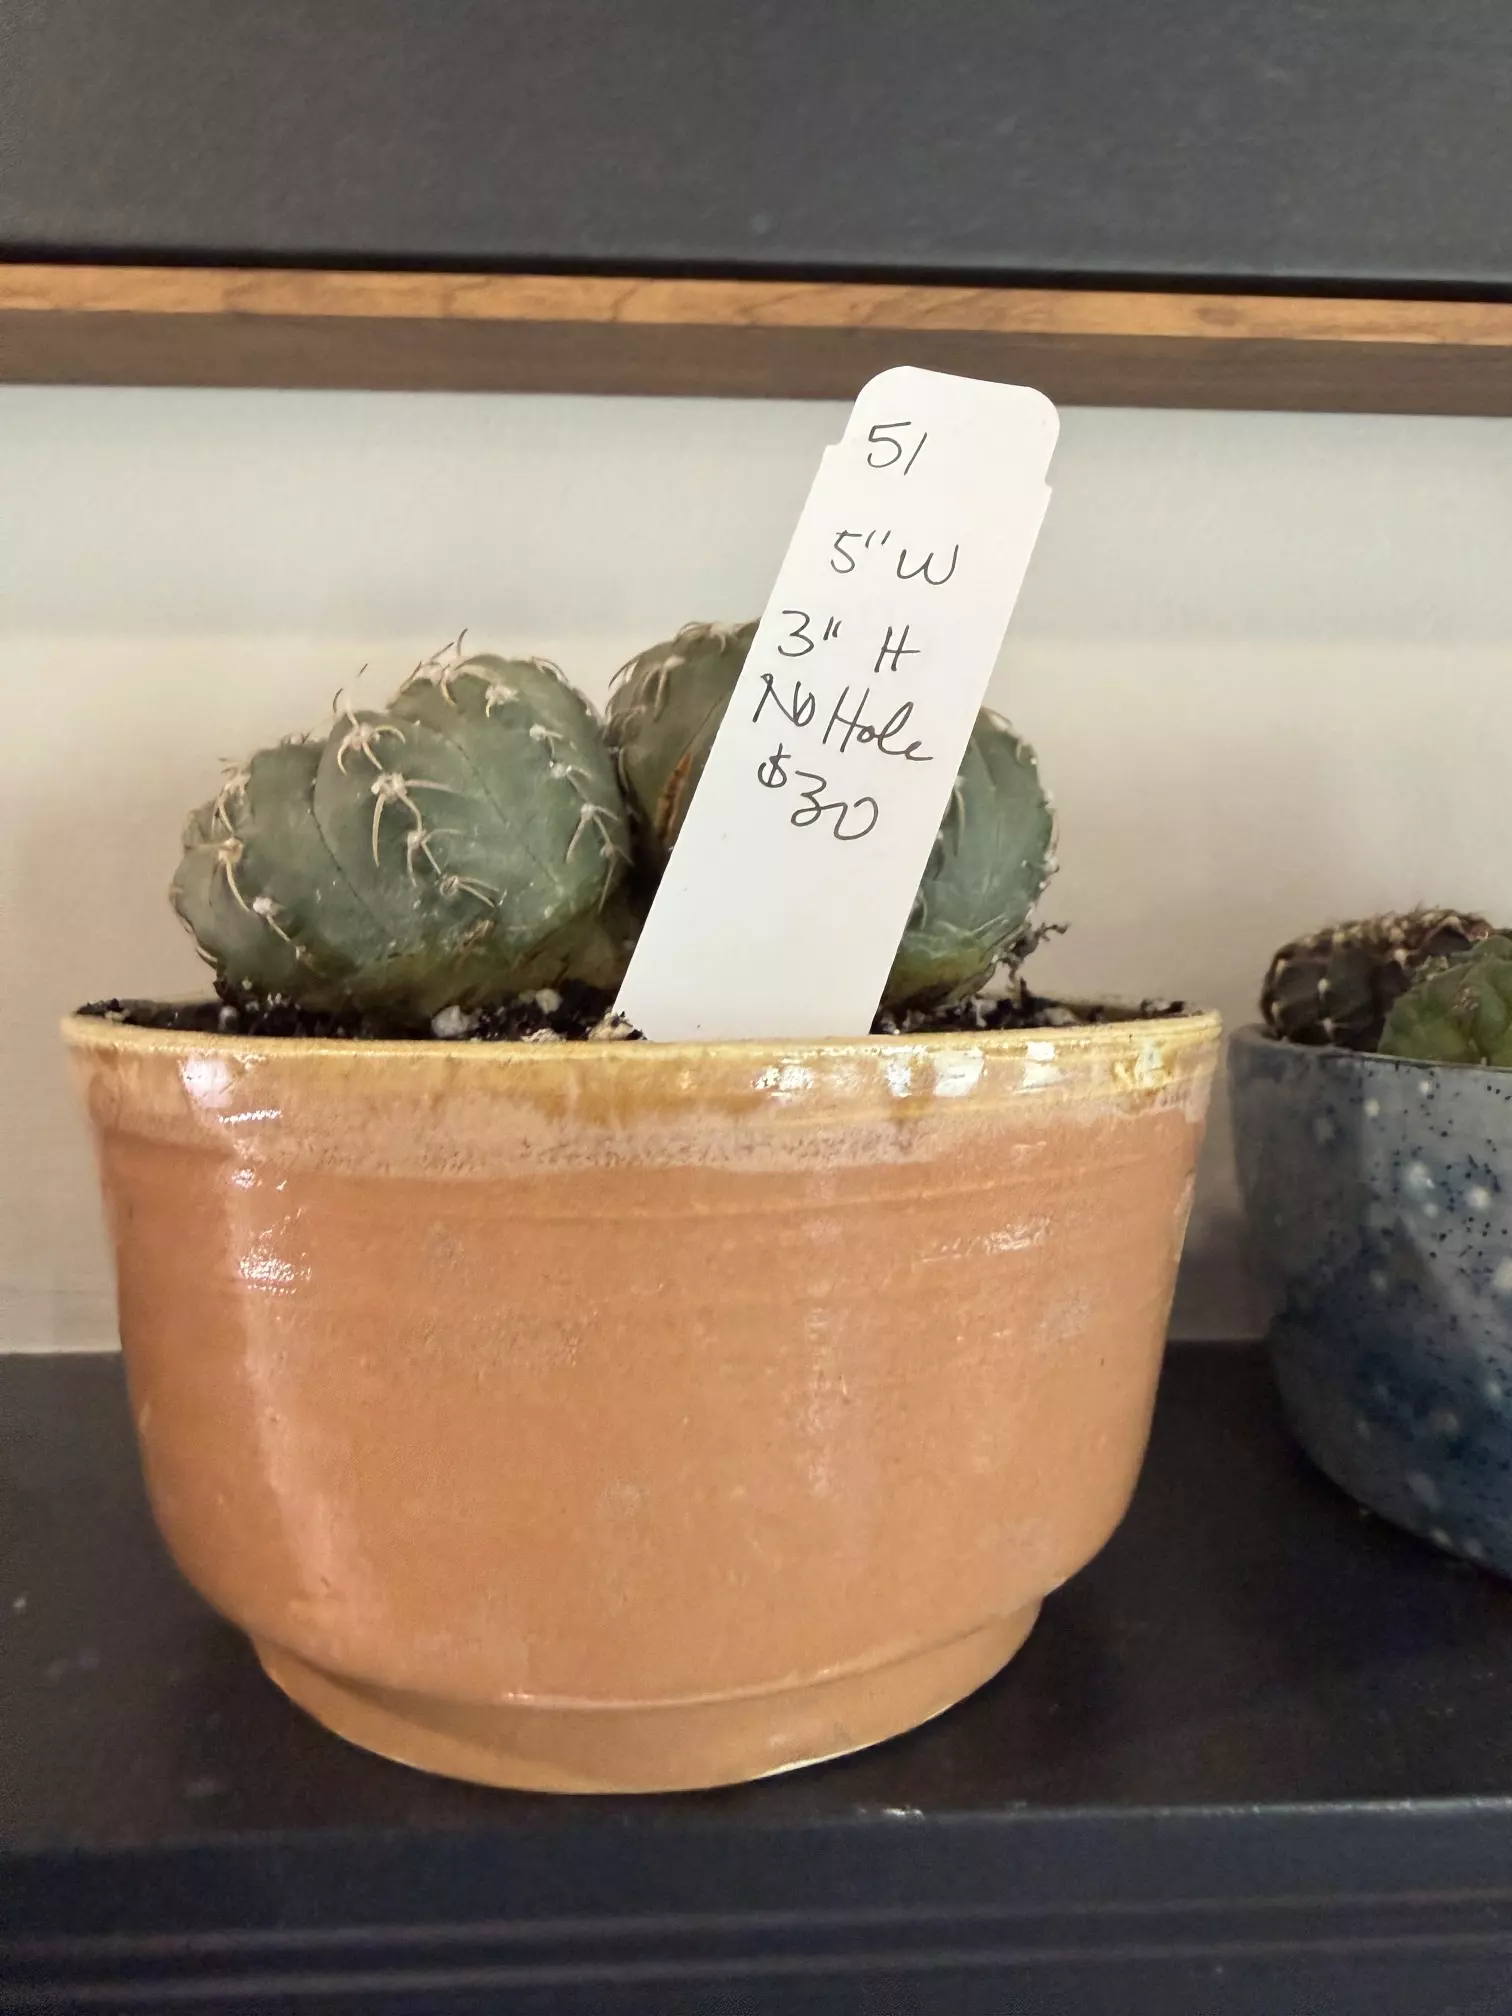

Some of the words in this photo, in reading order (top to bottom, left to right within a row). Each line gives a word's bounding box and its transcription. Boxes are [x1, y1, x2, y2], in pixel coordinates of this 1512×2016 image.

[866, 420, 928, 476] 51
[873, 623, 922, 674] H
[751, 672, 816, 728] No
[821, 684, 934, 762] Hole
[757, 742, 879, 842] $30
